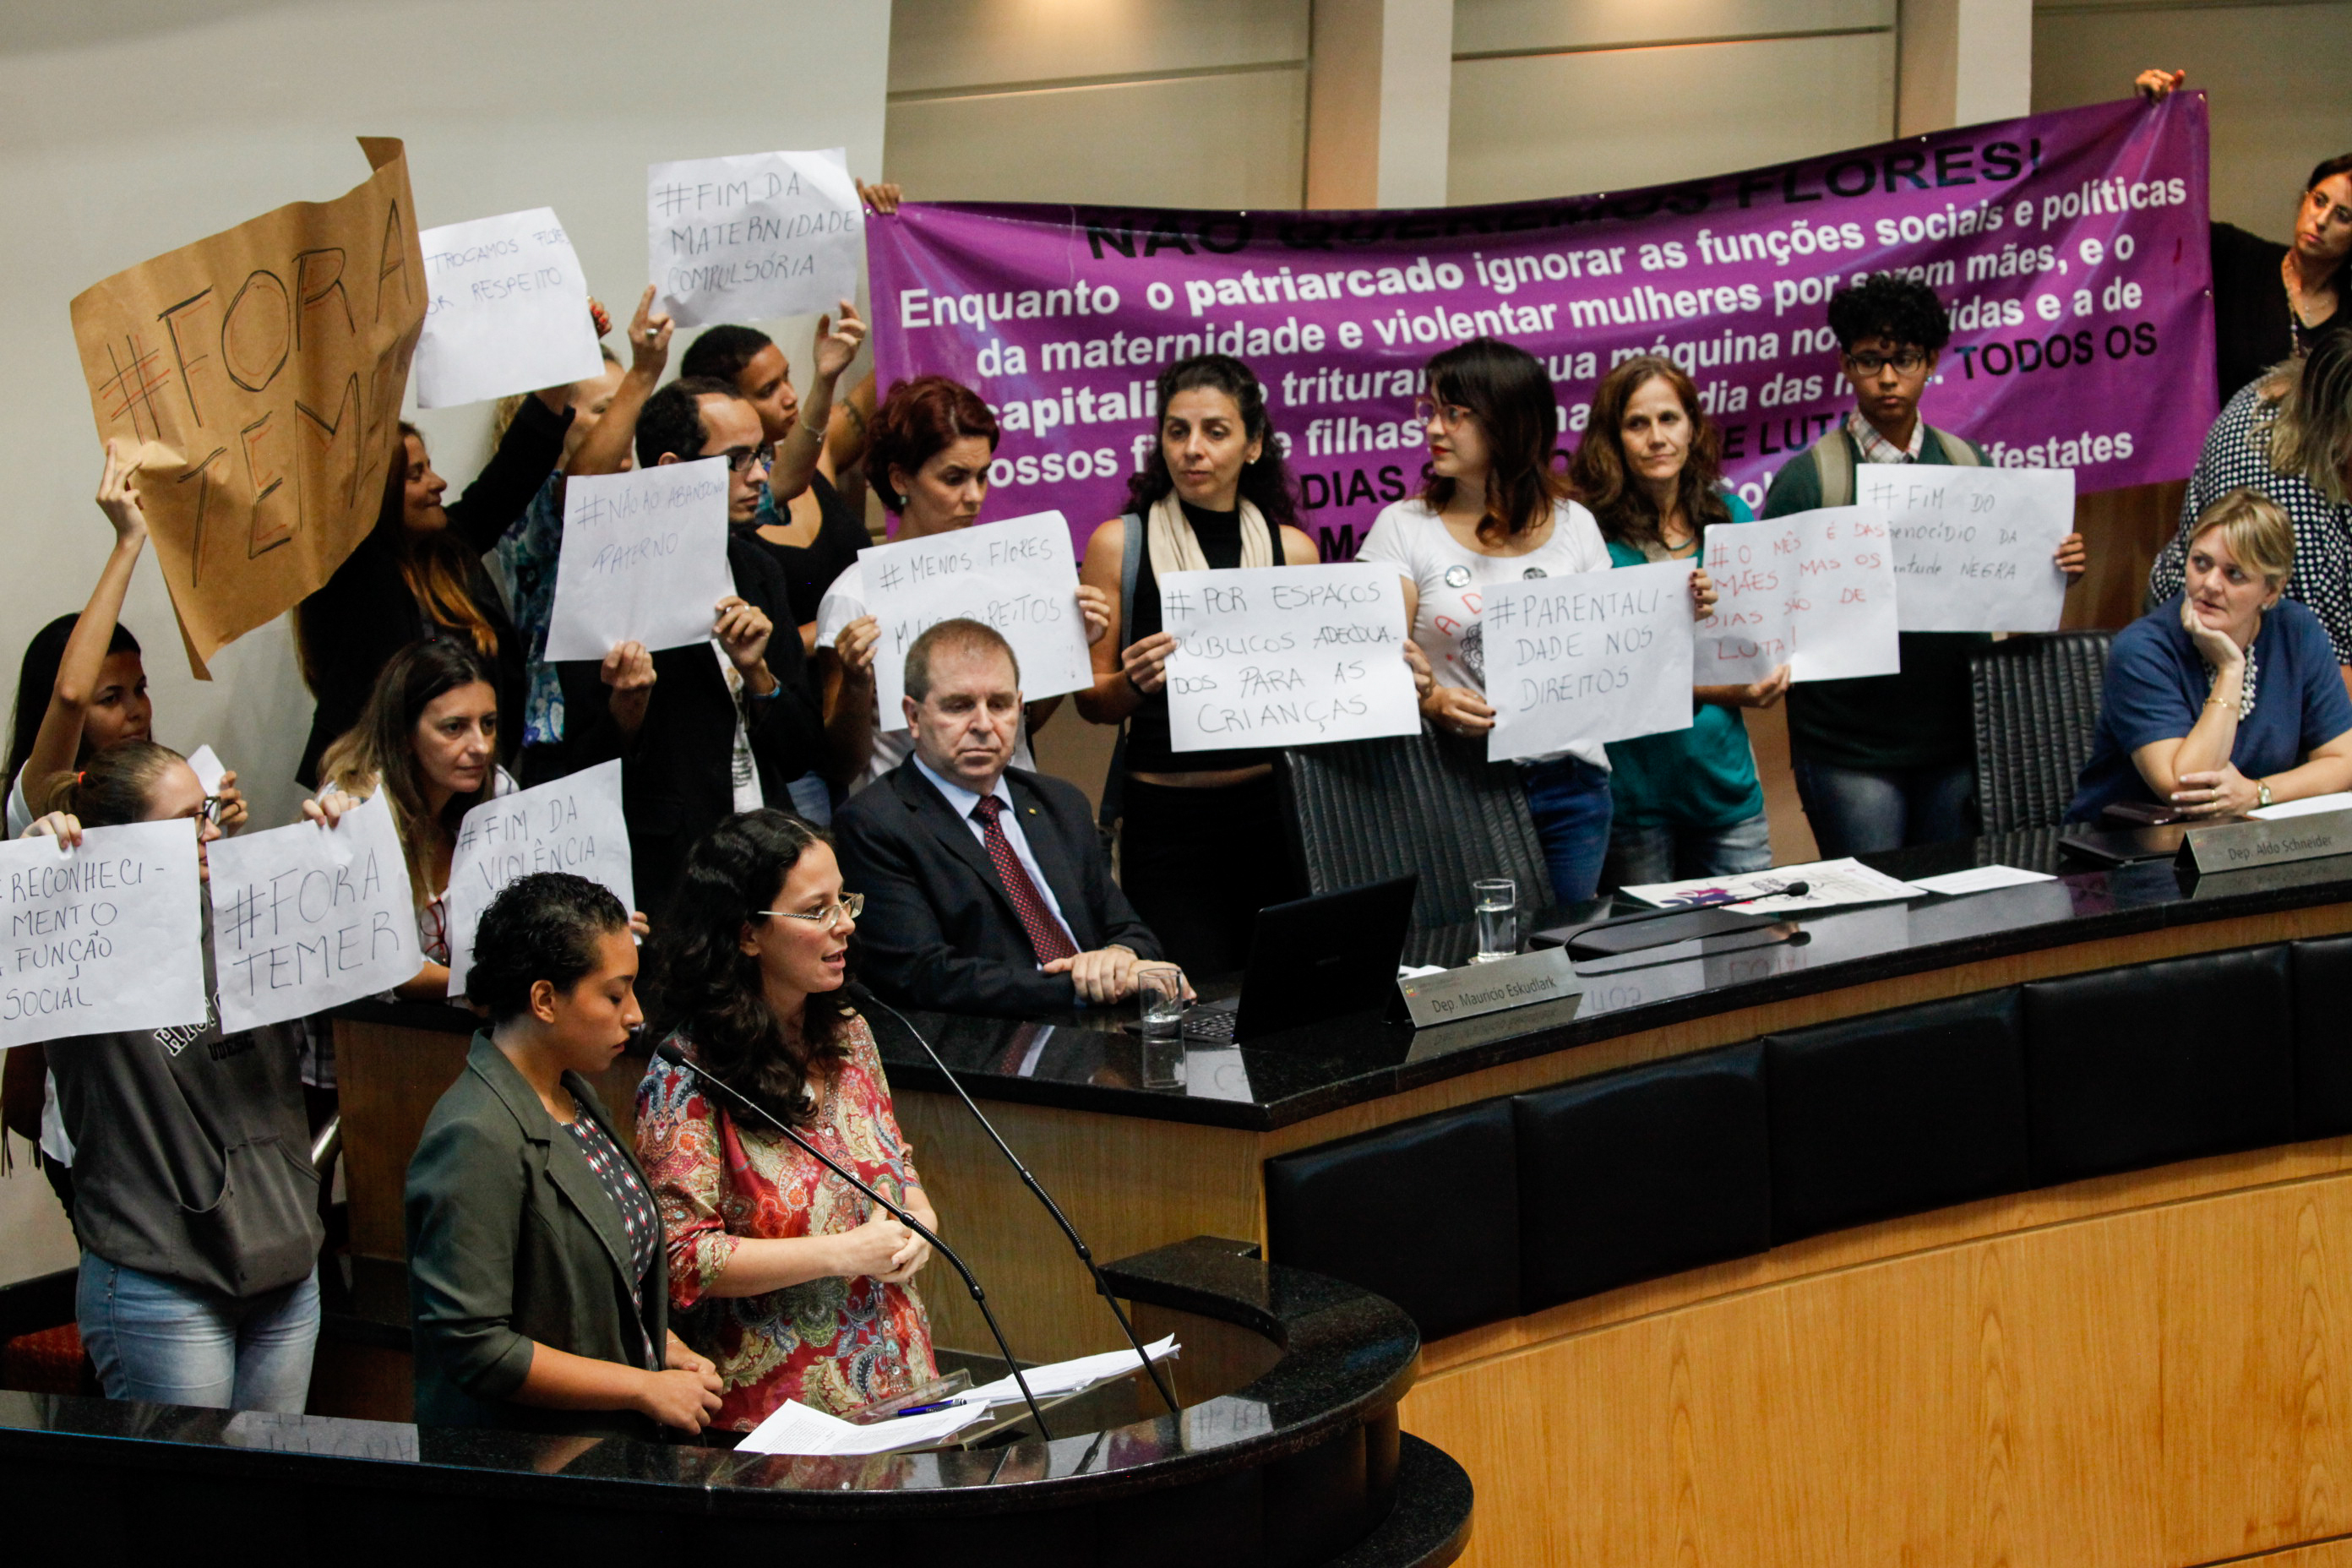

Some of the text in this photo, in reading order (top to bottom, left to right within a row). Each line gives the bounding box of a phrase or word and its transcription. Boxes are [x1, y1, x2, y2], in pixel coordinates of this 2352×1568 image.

[656, 172, 800, 216] #FIM DA
[1737, 138, 2040, 209] FLORES!
[672, 210, 857, 254] MATERNIDADE
[424, 239, 519, 274] TROCAMOS
[668, 251, 814, 294] COMPULSÓRIA
[901, 177, 2186, 331] Enquanto o patriarcado ignorar as funções sociais e políticas
[471, 267, 562, 302] RESPEITO
[1945, 297, 2024, 332] idas
[2036, 293, 2061, 320] e
[2074, 290, 2093, 316] a
[2103, 276, 2142, 313] de
[977, 338, 1027, 377] da
[1042, 317, 1325, 372] maternidade
[1338, 318, 1363, 349] e
[1373, 300, 1557, 346] violentar
[1569, 283, 1761, 328] mulheres
[1774, 275, 1839, 316] por
[1968, 242, 2068, 282] mães,
[2079, 237, 2104, 265] e
[2115, 234, 2135, 260] o
[1759, 373, 1822, 407] das
[1954, 329, 2093, 378] TODOS
[2105, 322, 2157, 359] OS
[644, 490, 659, 515] AO
[1300, 466, 1406, 509] DIAS
[1971, 493, 1995, 513] DO
[1774, 531, 1801, 556] MÊS
[1827, 520, 1836, 540] É
[1854, 523, 1885, 537] DAS
[2000, 528, 2017, 545] DA
[1800, 559, 1841, 575] MAS
[1855, 553, 1881, 569] OS
[1271, 581, 1380, 609] ESPAÇOS
[1839, 588, 1866, 604] DE
[1516, 625, 1652, 666] DADE NOS
[1173, 661, 1365, 698] DOS PARA AS
[1520, 666, 1629, 711] DIREITOS
[1197, 694, 1367, 732] CRIANÇAS
[460, 795, 577, 852] #FIM DA
[478, 836, 595, 890] VIOLÊNCIA
[2228, 835, 2332, 861] Dep. Aldo Schneider
[225, 847, 379, 950] #FORA
[13, 902, 117, 937] MENTO
[15, 930, 112, 979] FUNÇÃO
[232, 911, 398, 996] TEMER
[3, 986, 93, 1020] SOCIAL
[1432, 999, 1458, 1014] Dep.
[1507, 975, 1557, 997] Eskudlark
